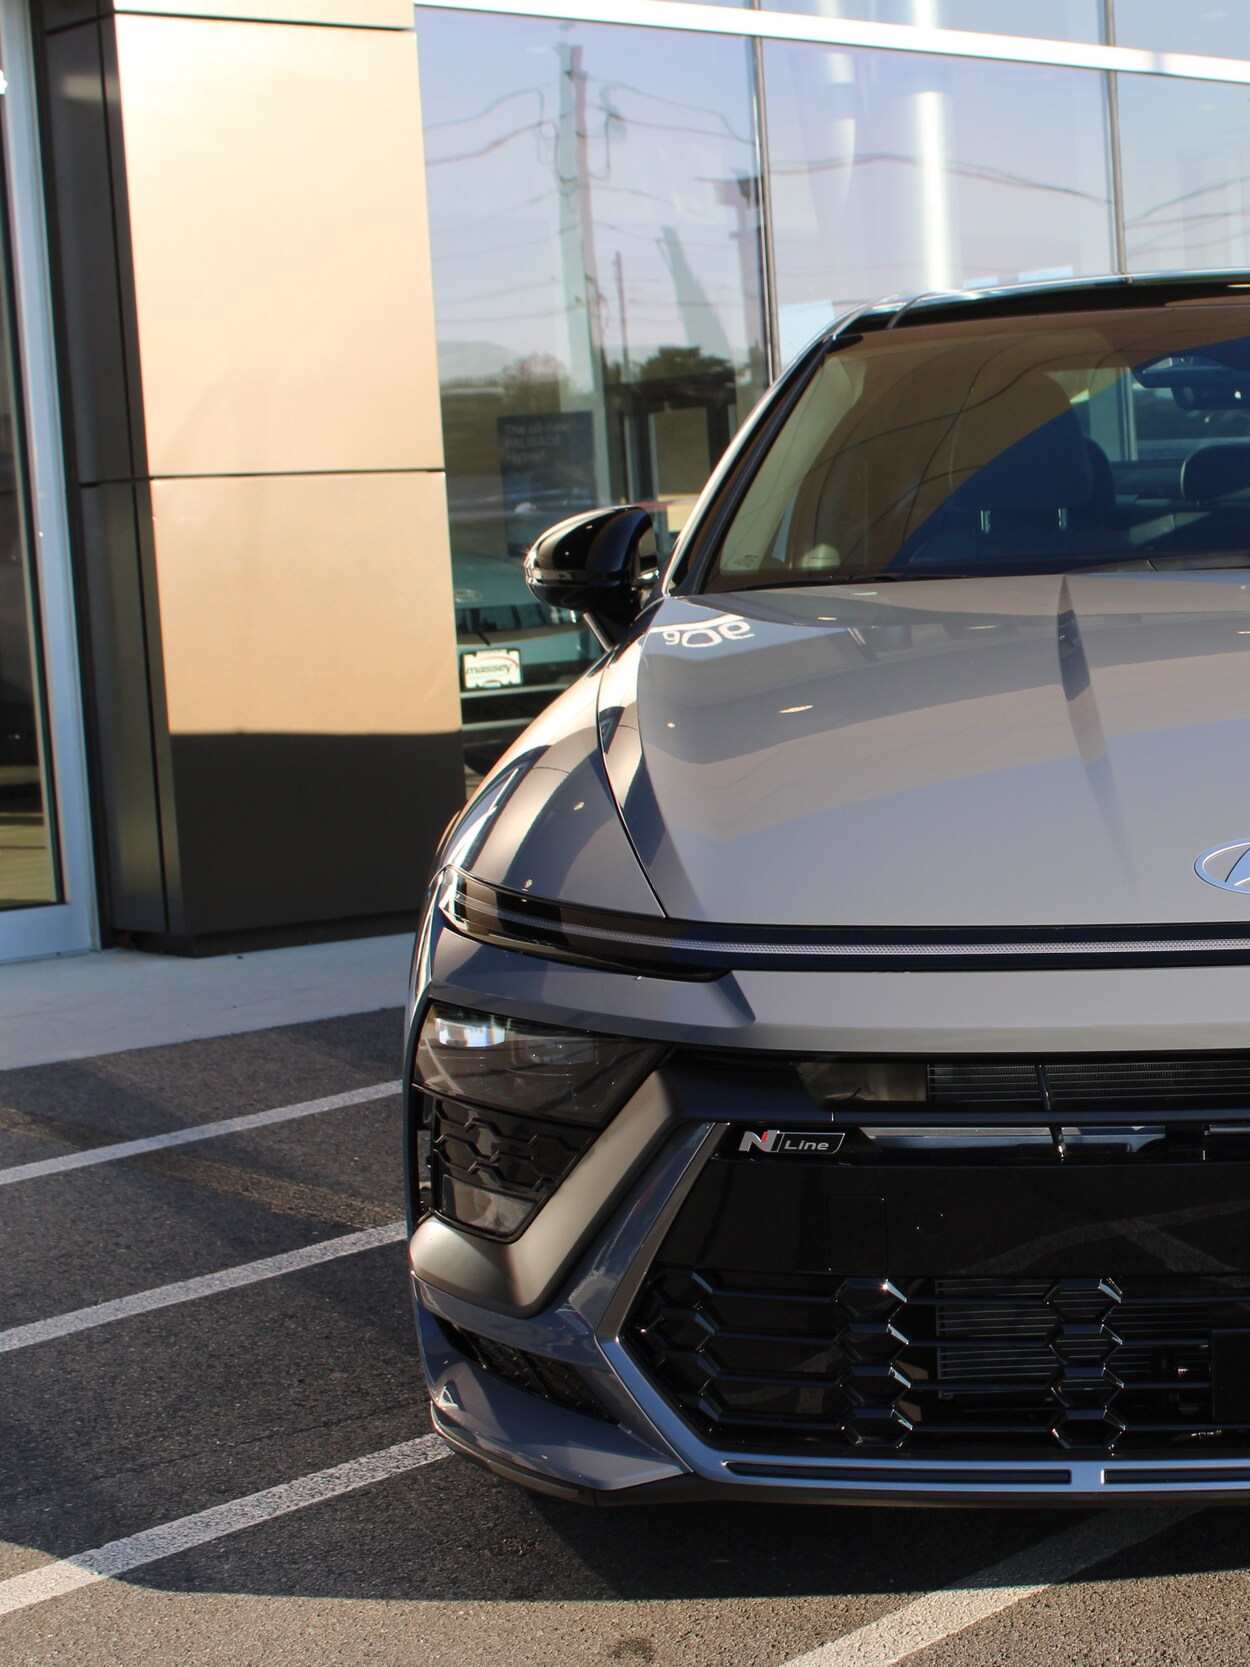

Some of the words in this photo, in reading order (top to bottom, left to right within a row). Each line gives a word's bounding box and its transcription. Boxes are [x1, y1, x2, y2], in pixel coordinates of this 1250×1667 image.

[465, 664, 512, 674] massey
[738, 1130, 780, 1152] N
[784, 1140, 829, 1151] Line
